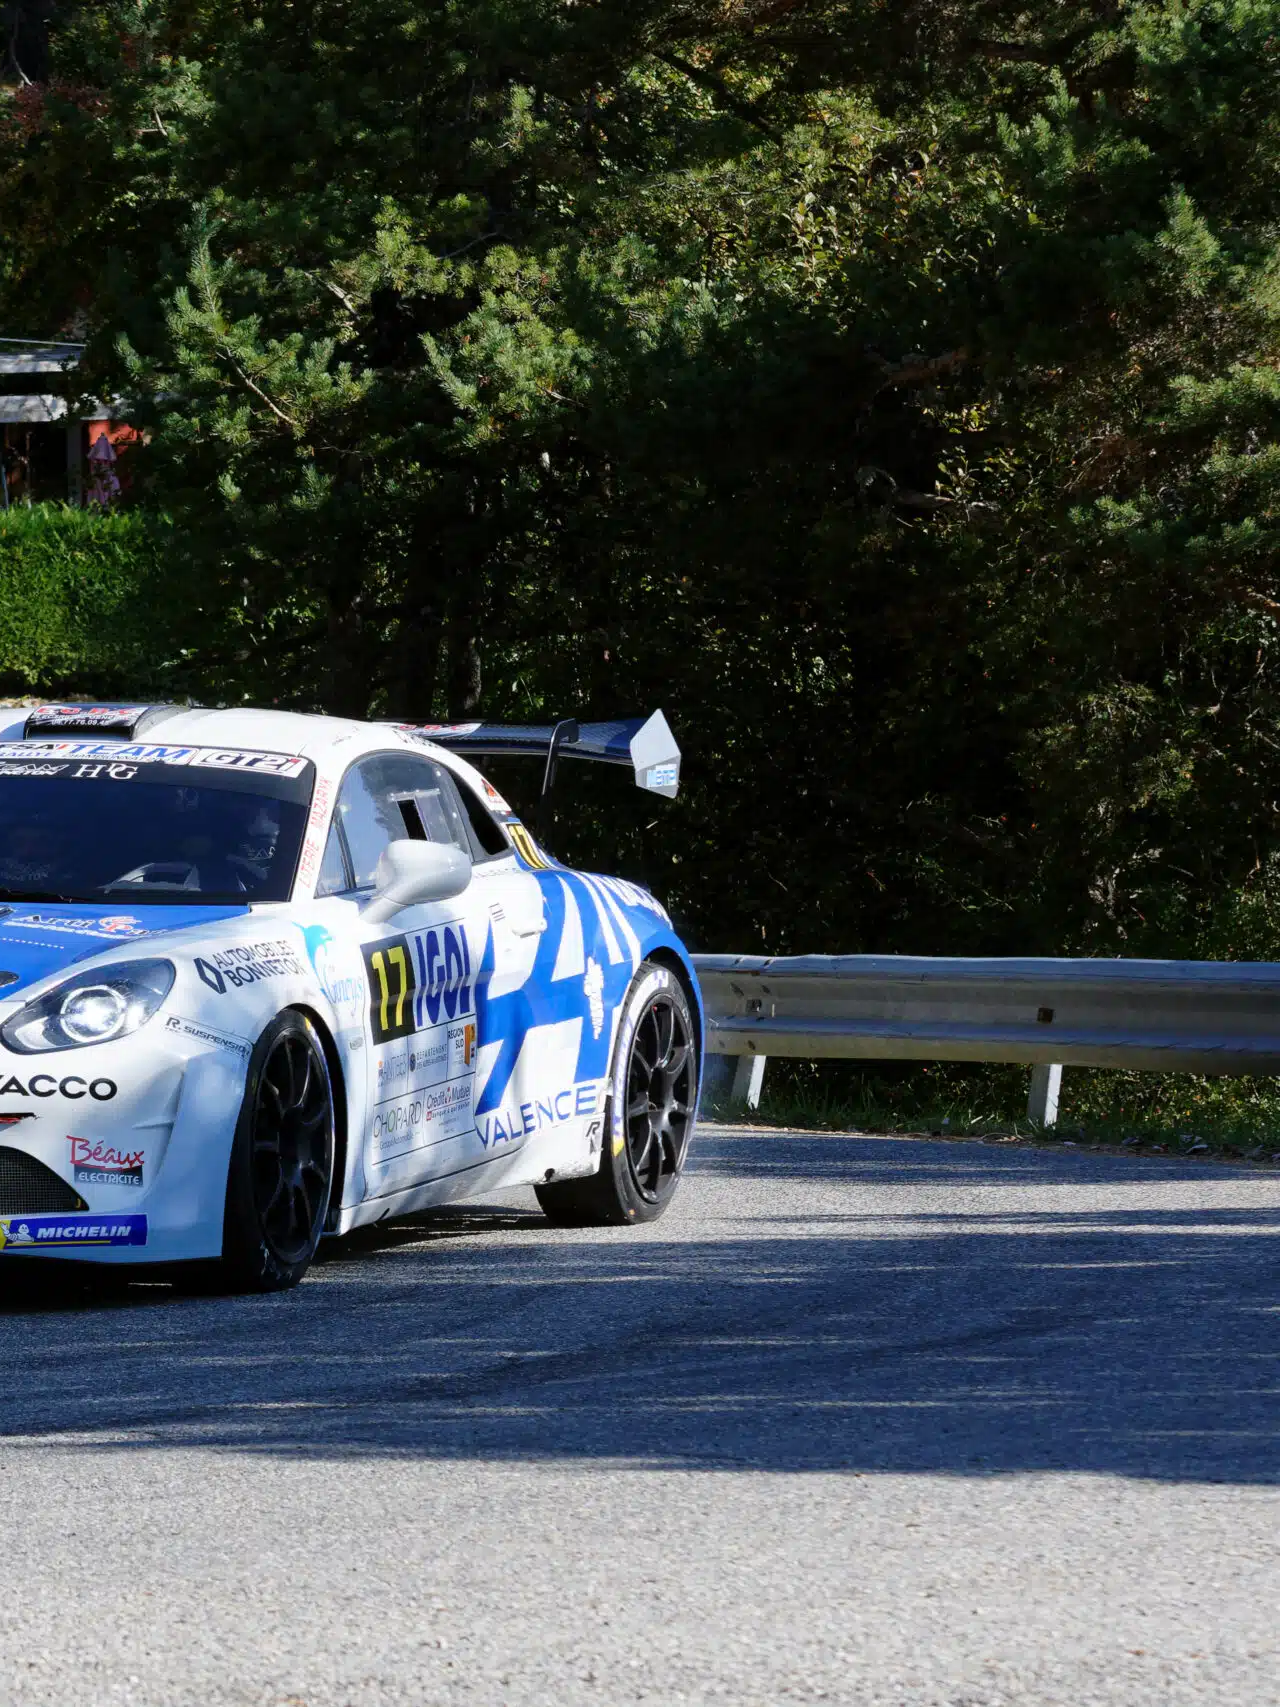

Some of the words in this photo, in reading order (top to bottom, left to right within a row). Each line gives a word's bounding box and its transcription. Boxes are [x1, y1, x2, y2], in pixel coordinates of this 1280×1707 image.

[70, 743, 193, 760] TEAM
[207, 751, 301, 772] GT2i
[212, 940, 295, 969] AUTOMOBILES
[223, 957, 307, 988] BONNETON
[415, 924, 471, 1028] IGOL
[372, 946, 407, 1031] 17
[373, 1101, 422, 1138] CHOPARD
[475, 1084, 597, 1151] VALENCE
[78, 1171, 140, 1185] ELECTRICITE
[36, 1223, 132, 1239] MICHELIN
